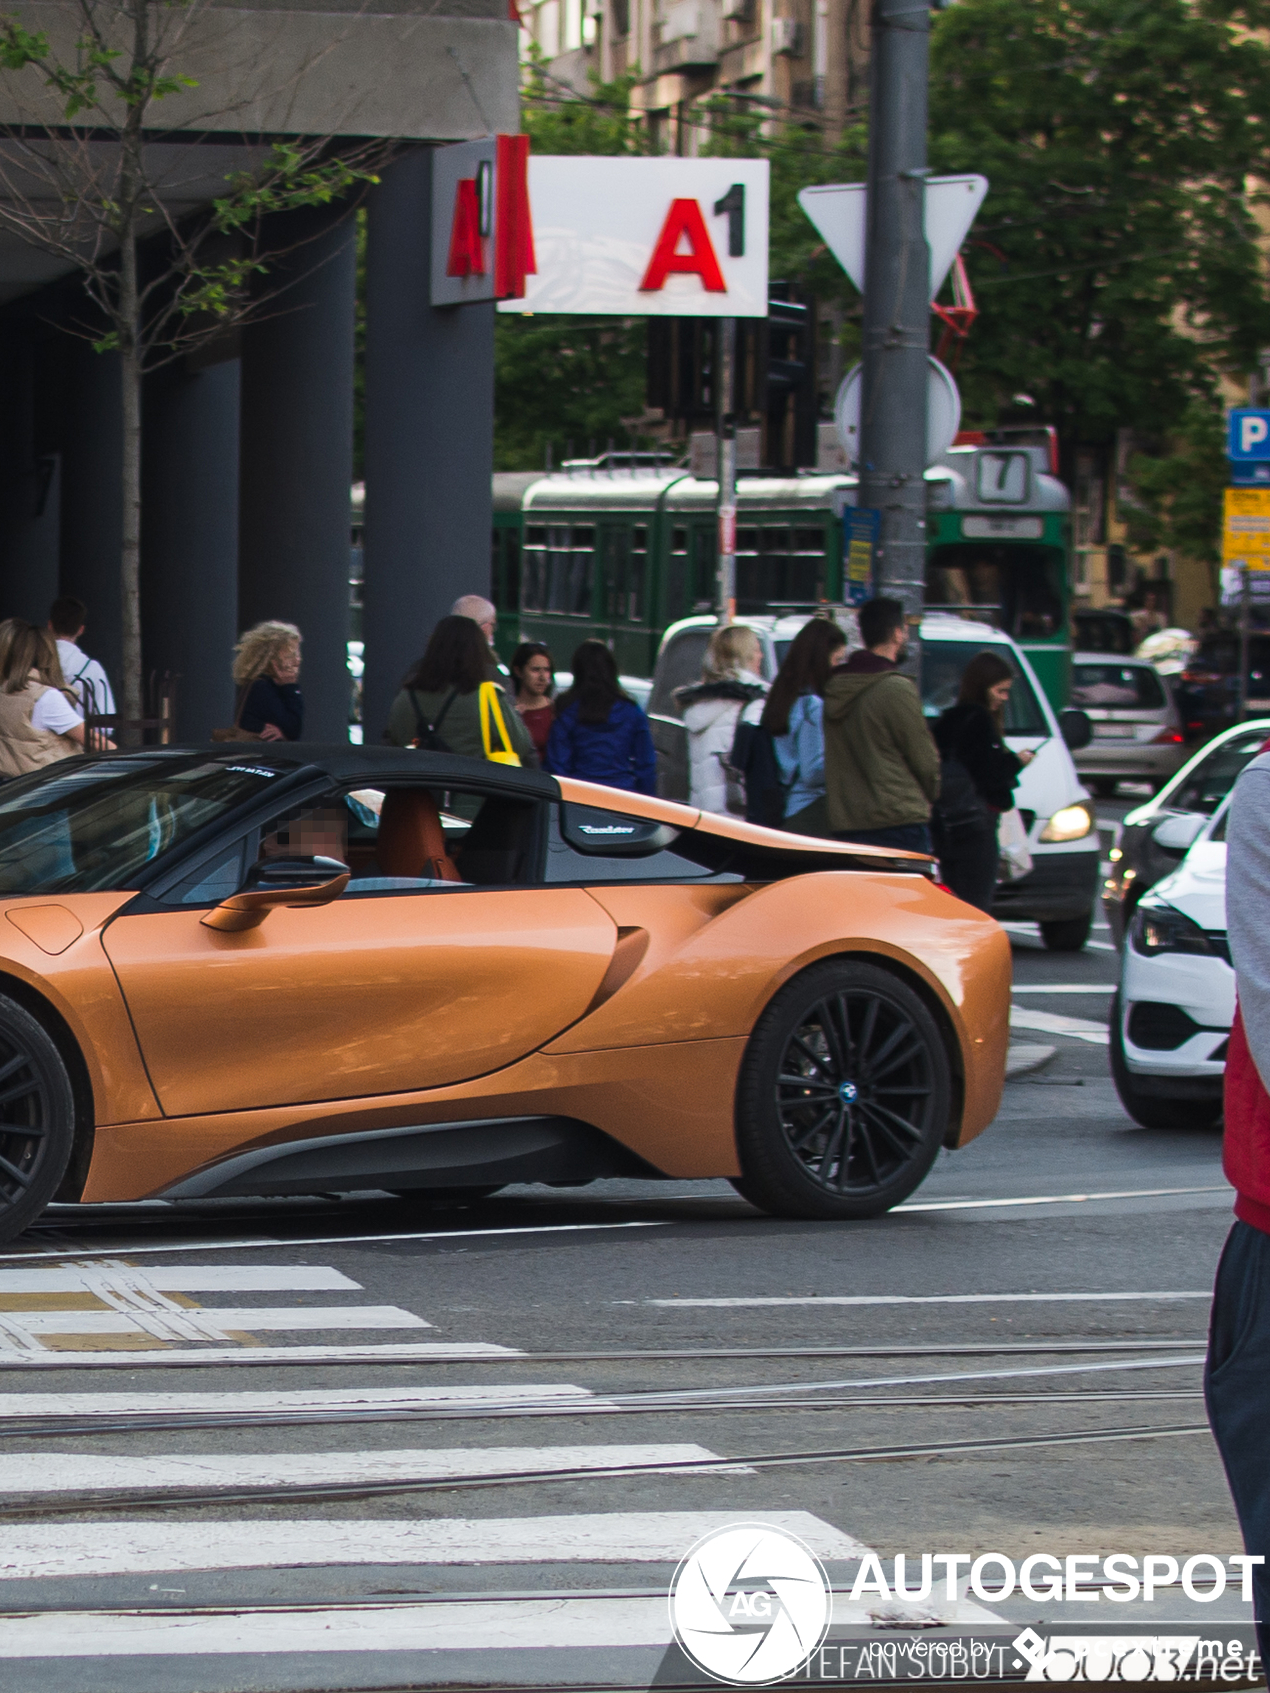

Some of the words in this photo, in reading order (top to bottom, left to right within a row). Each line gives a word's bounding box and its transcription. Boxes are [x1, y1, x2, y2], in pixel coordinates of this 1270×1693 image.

[639, 183, 745, 293] A1
[1241, 416, 1268, 452] P
[993, 454, 1013, 490] 7
